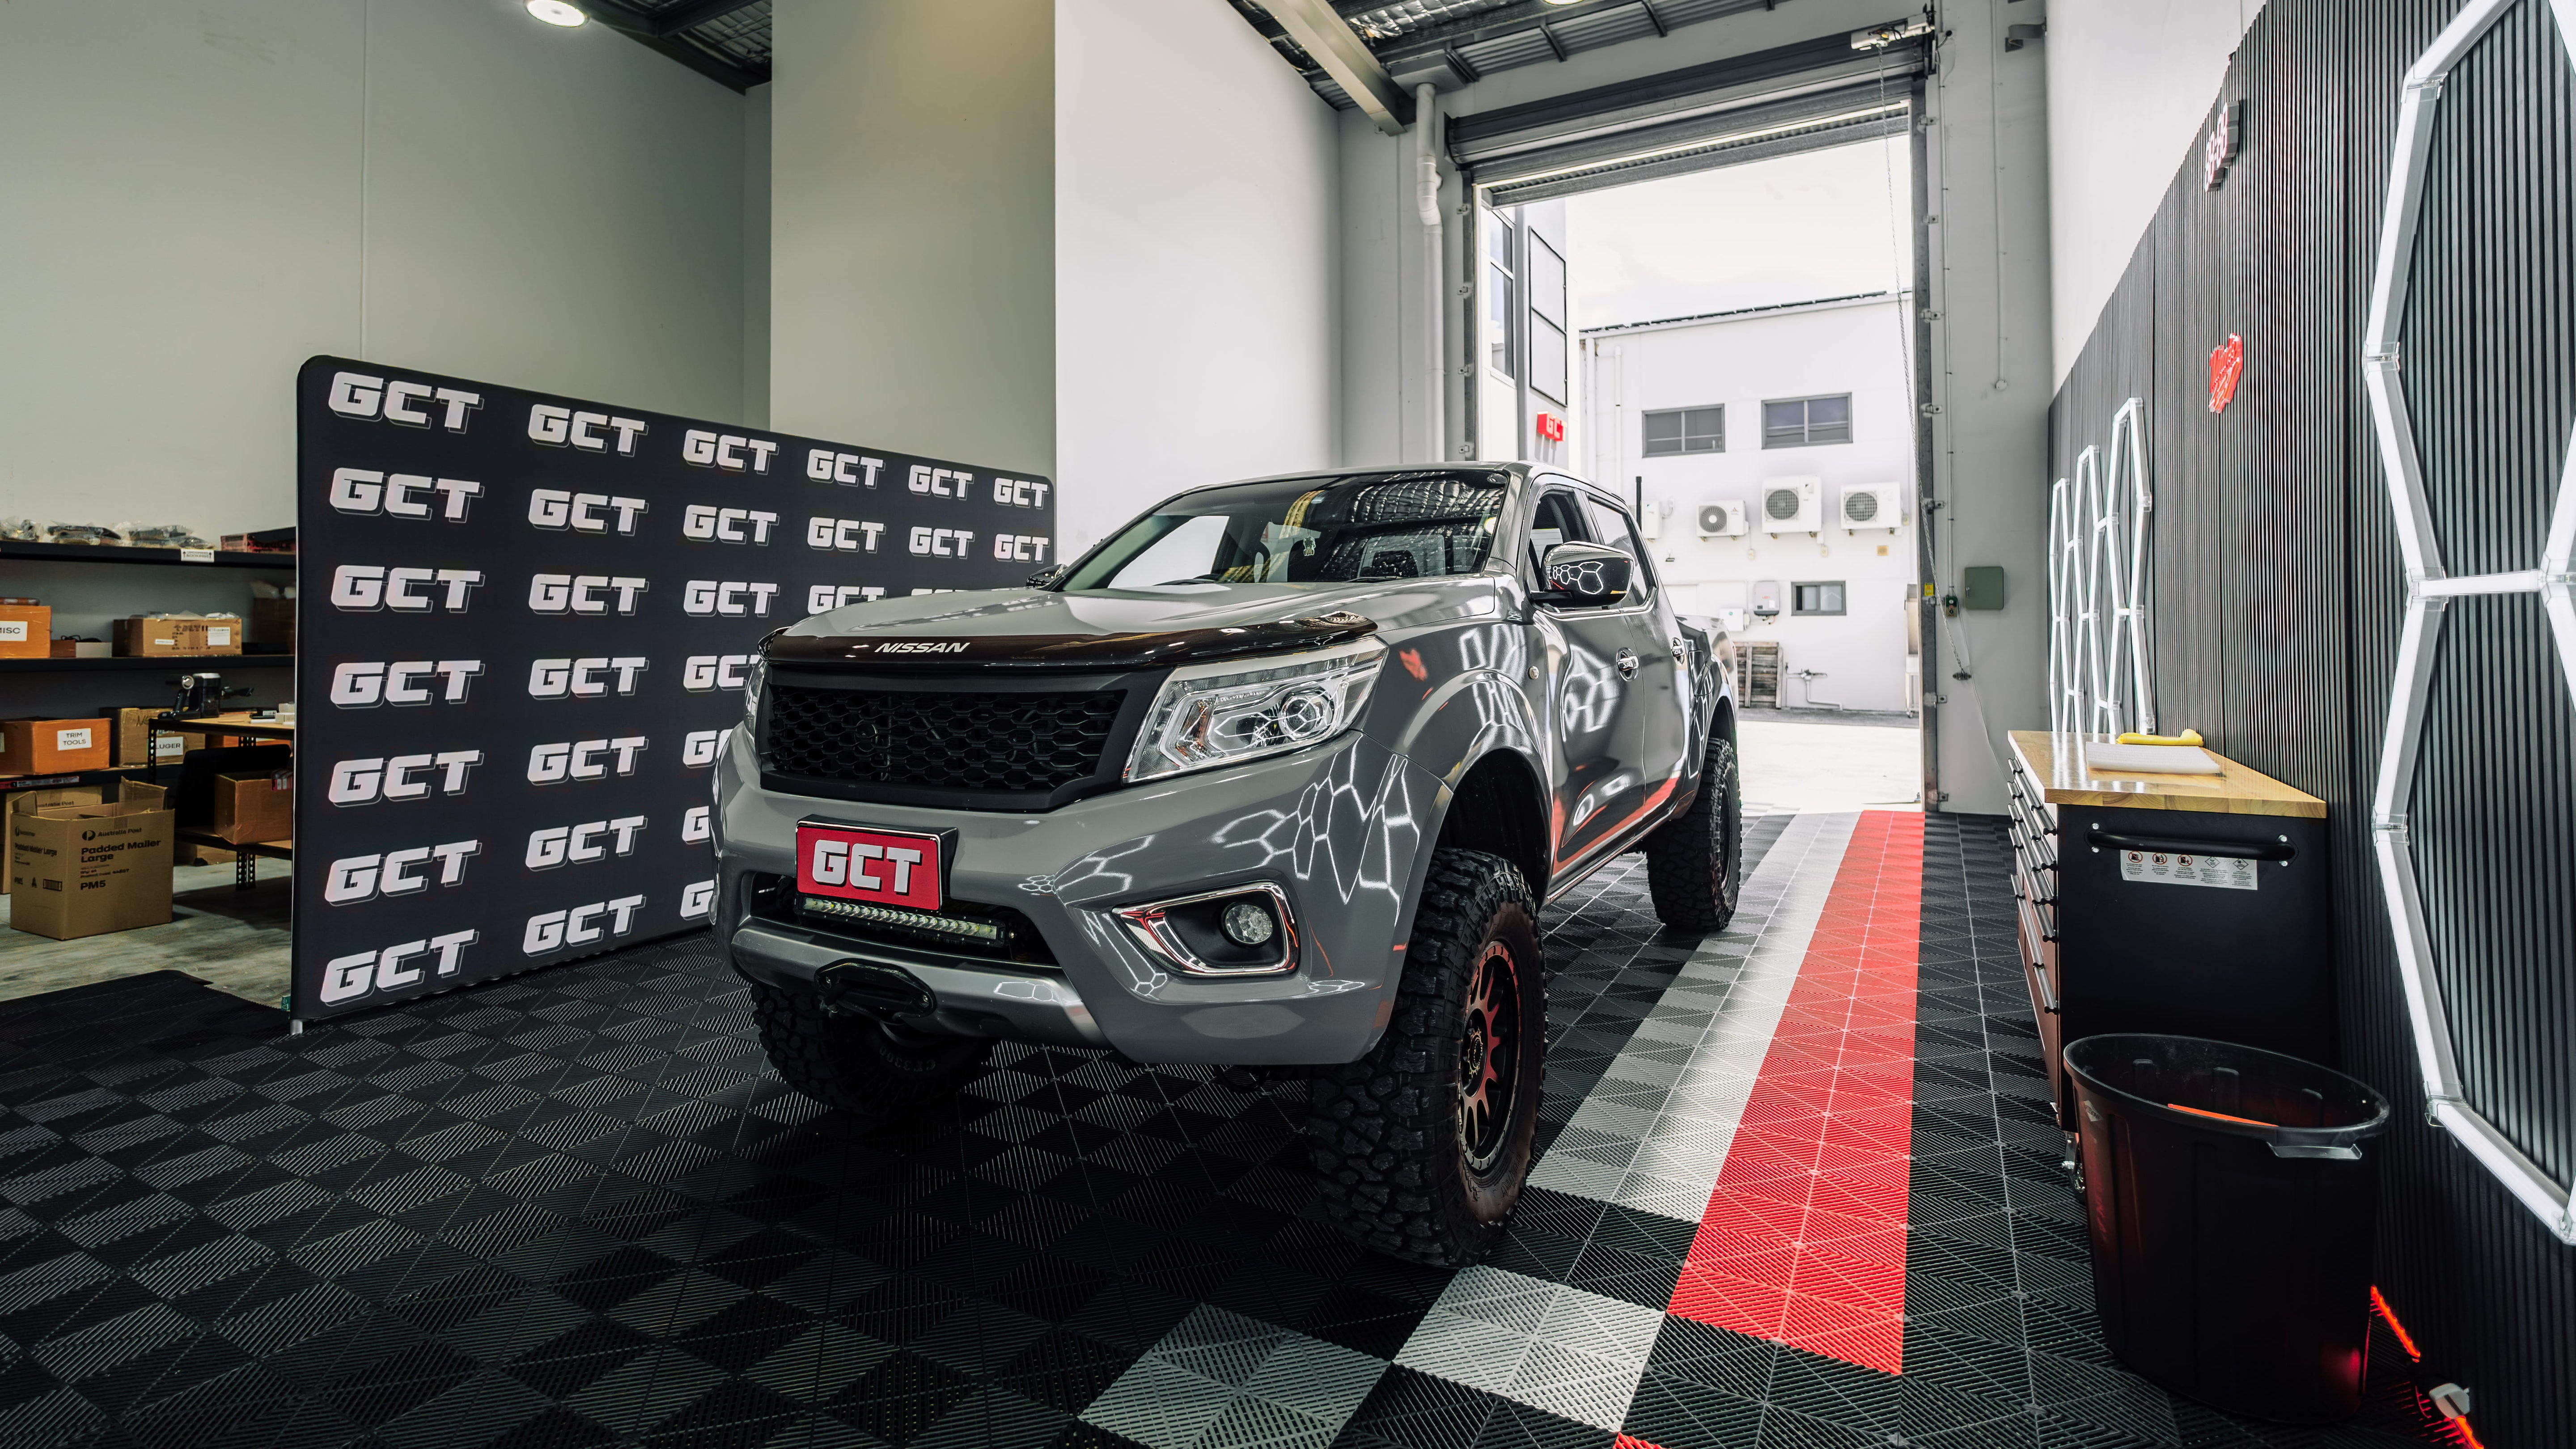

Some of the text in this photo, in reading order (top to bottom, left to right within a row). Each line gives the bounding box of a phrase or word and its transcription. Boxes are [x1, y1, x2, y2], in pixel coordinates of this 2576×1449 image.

[328, 372, 482, 431] GCT
[528, 404, 647, 454] GCT
[1544, 411, 1568, 442] GCT
[683, 429, 778, 473] GCT
[807, 449, 884, 487] GCT
[330, 467, 482, 521] GCT
[908, 465, 974, 499] GCT
[993, 478, 1048, 508] GCT
[528, 489, 647, 534] GCT
[683, 504, 778, 544] GCT
[807, 517, 885, 551] GCT
[909, 526, 974, 557] GCT
[994, 534, 1049, 562] GCT
[330, 565, 483, 610] GCT
[529, 574, 648, 614] GCT
[683, 580, 779, 615] GCT
[875, 642, 970, 653] NISSAN
[330, 660, 483, 707] GCT
[528, 657, 648, 698] GCT
[683, 655, 759, 689] GC
[328, 750, 482, 805] GCT
[527, 736, 647, 784] GCT
[81, 839, 161, 855] Padded Mailer
[98, 829, 127, 837] Australia
[525, 815, 646, 870] GCT
[81, 853, 114, 863] Large
[324, 839, 480, 904] GCT
[812, 839, 921, 894] GCT
[80, 880, 106, 890] PM5
[523, 894, 644, 955] GCT
[320, 929, 477, 1005] GCT
